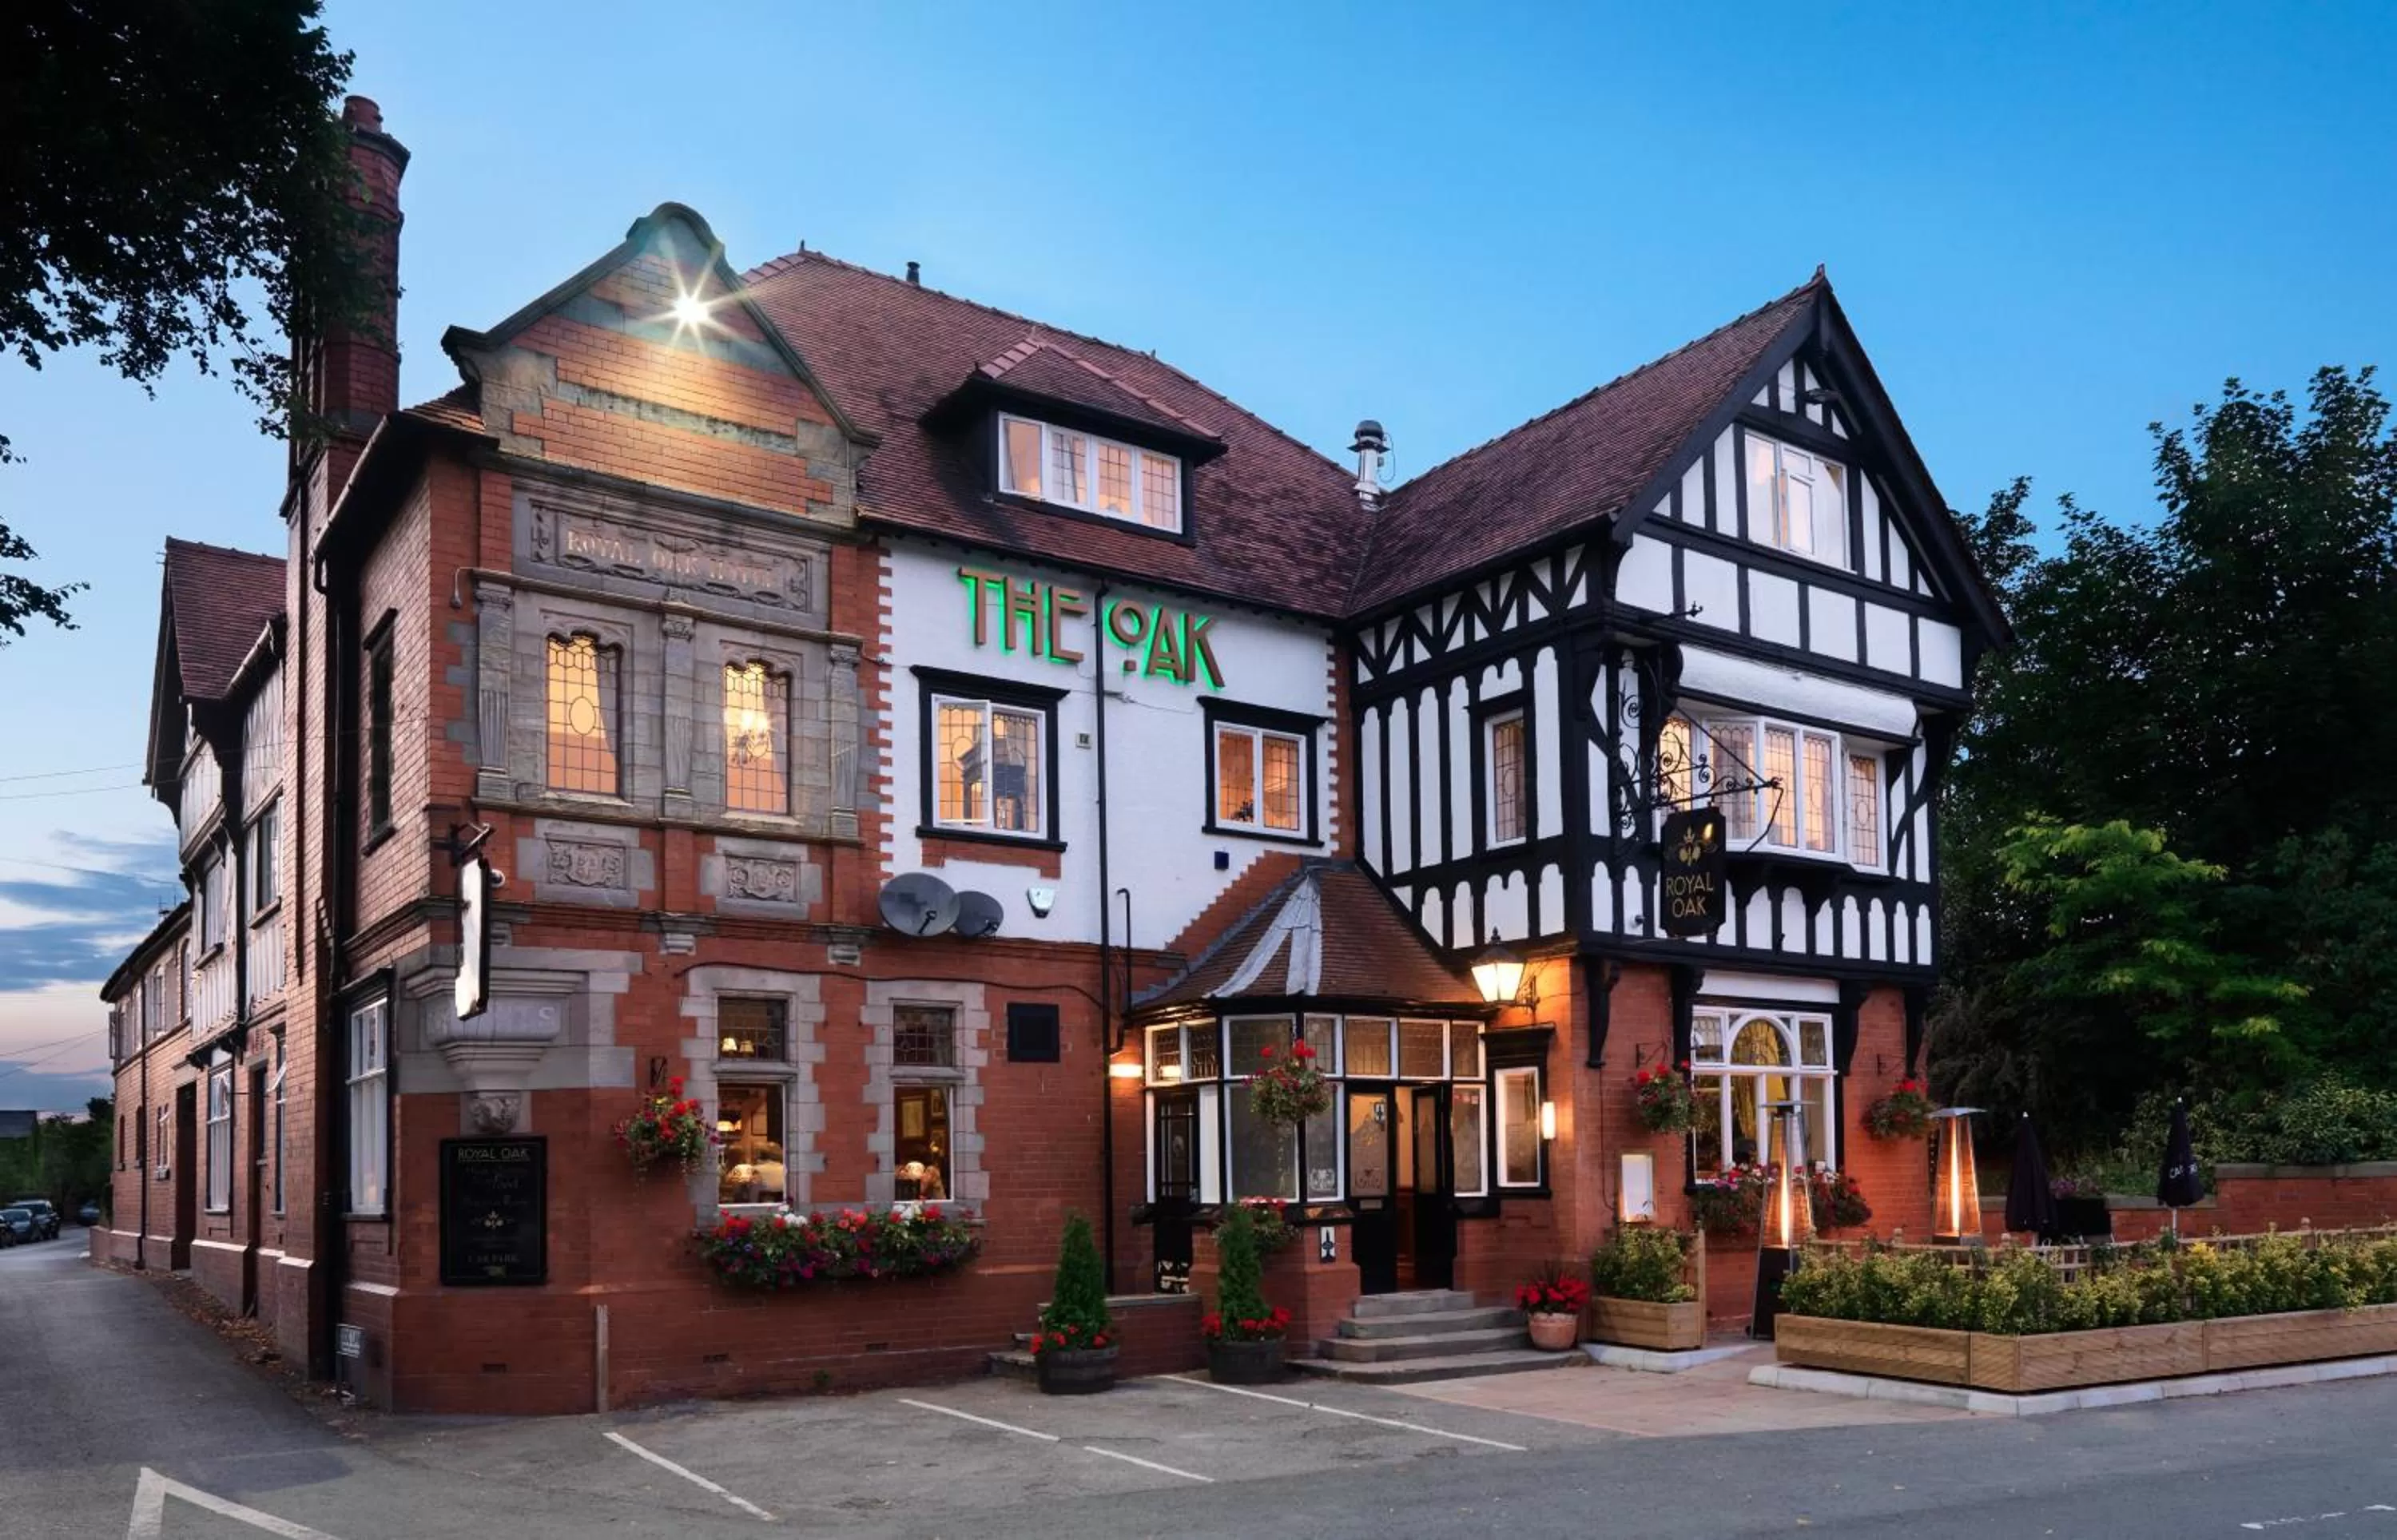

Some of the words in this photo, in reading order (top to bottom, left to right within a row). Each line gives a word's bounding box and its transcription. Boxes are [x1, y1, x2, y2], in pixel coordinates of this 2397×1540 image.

[567, 530, 641, 564] ROYAL
[652, 550, 698, 574] OAK
[958, 566, 1088, 663] THE
[1107, 599, 1226, 689] OAK
[1665, 871, 1714, 897] ROYAL
[1672, 896, 1707, 918] OAK
[458, 1147, 496, 1159] ROYAL
[501, 1147, 531, 1160] OAK
